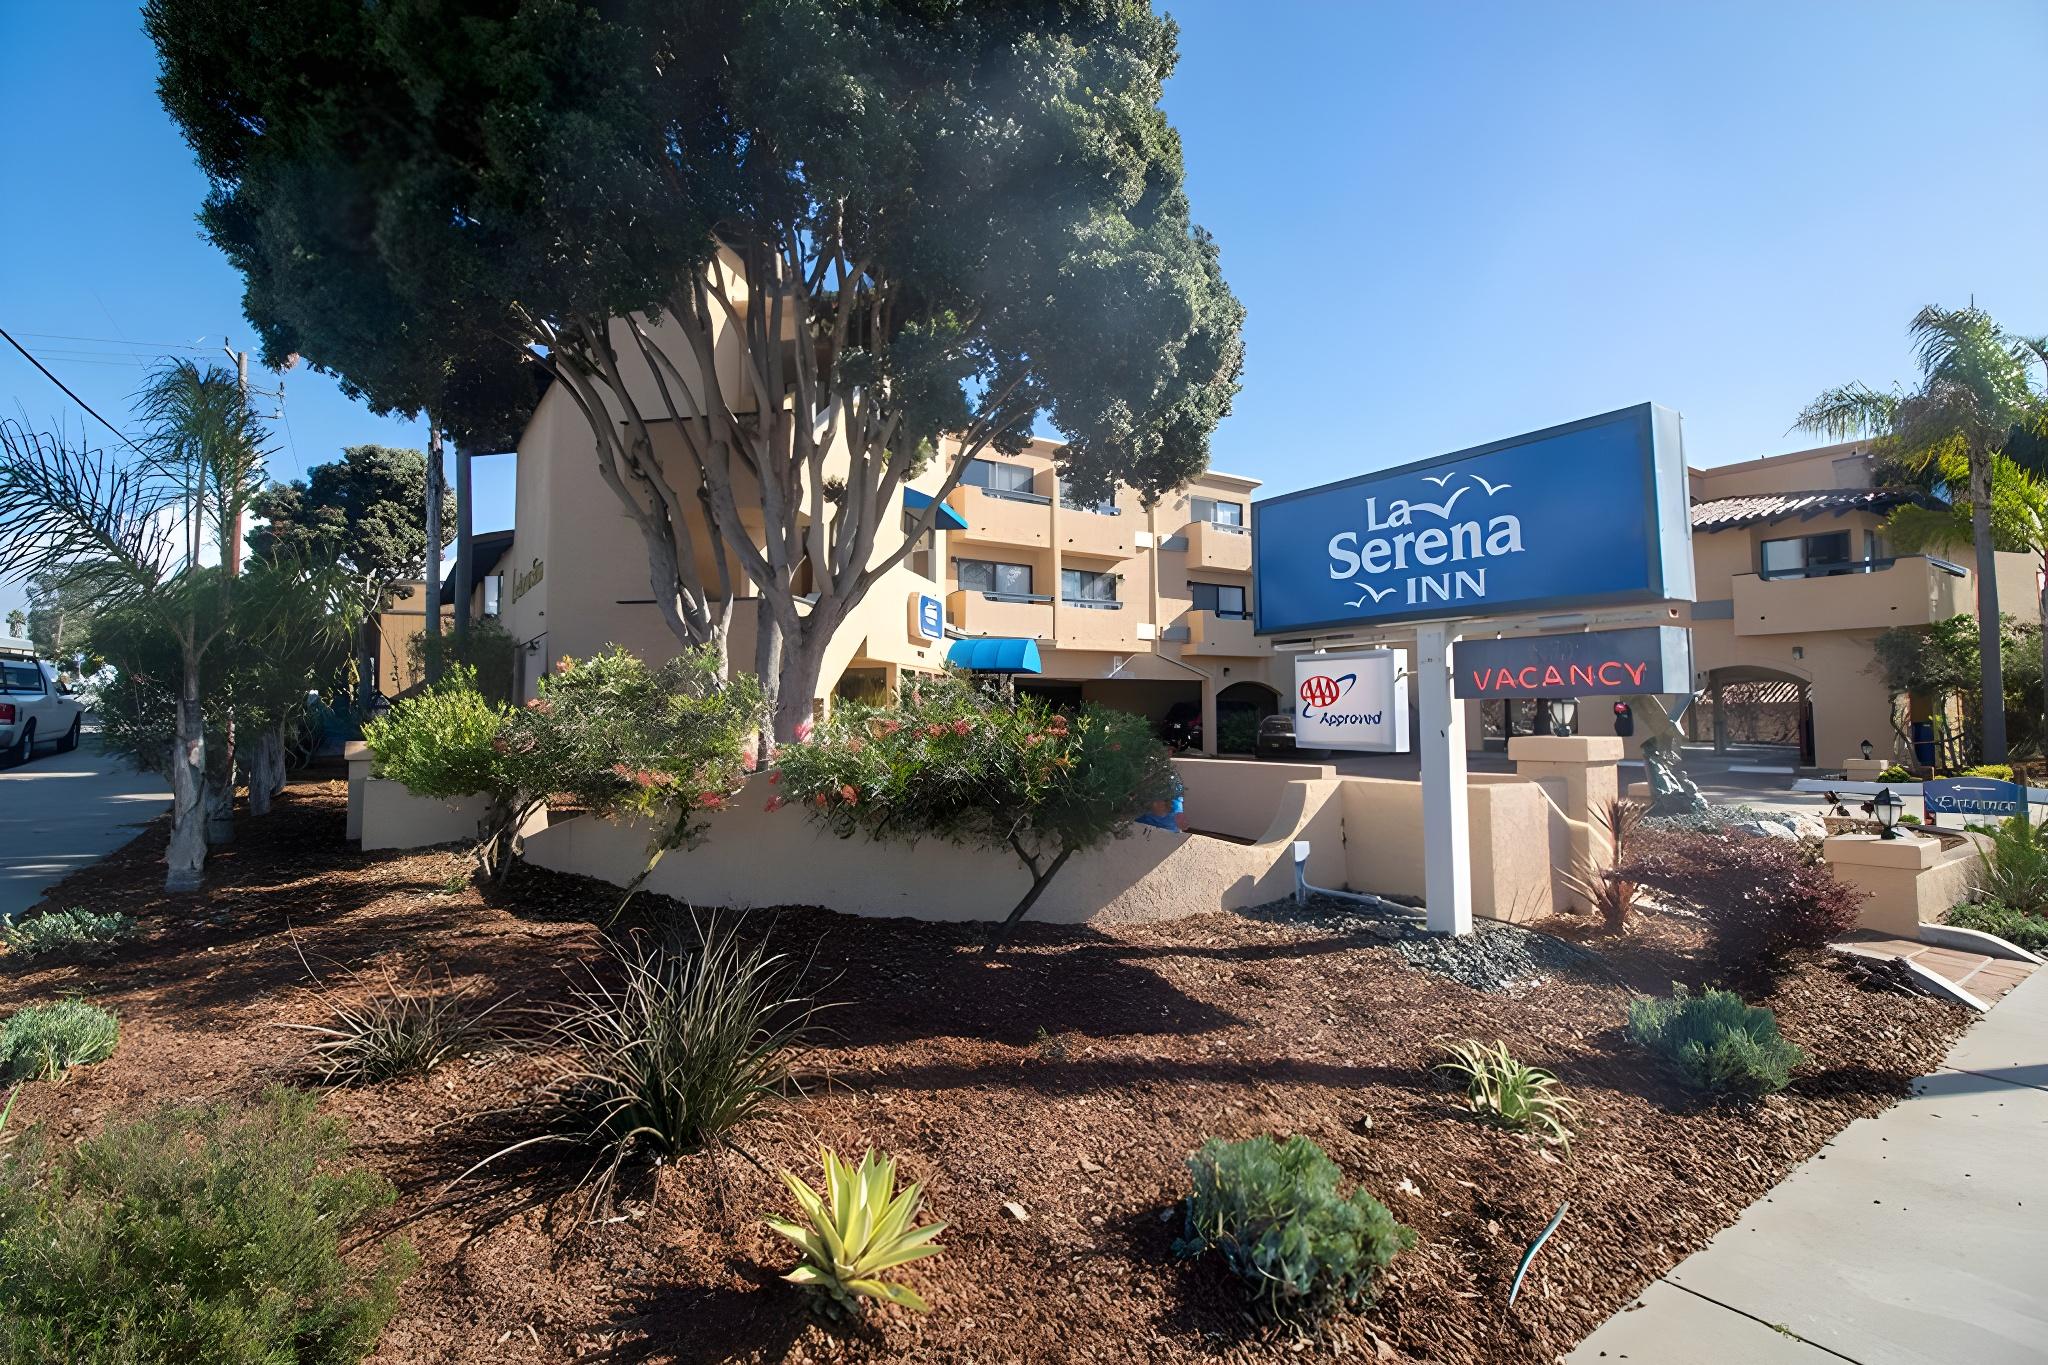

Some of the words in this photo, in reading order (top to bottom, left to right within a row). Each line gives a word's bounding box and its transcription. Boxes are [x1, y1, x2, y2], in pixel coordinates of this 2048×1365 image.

[1366, 497, 1412, 532] La
[1328, 514, 1525, 579] Serena
[1406, 568, 1487, 604] INN
[1302, 676, 1339, 707] AAA
[1473, 661, 1647, 691] VACANCY
